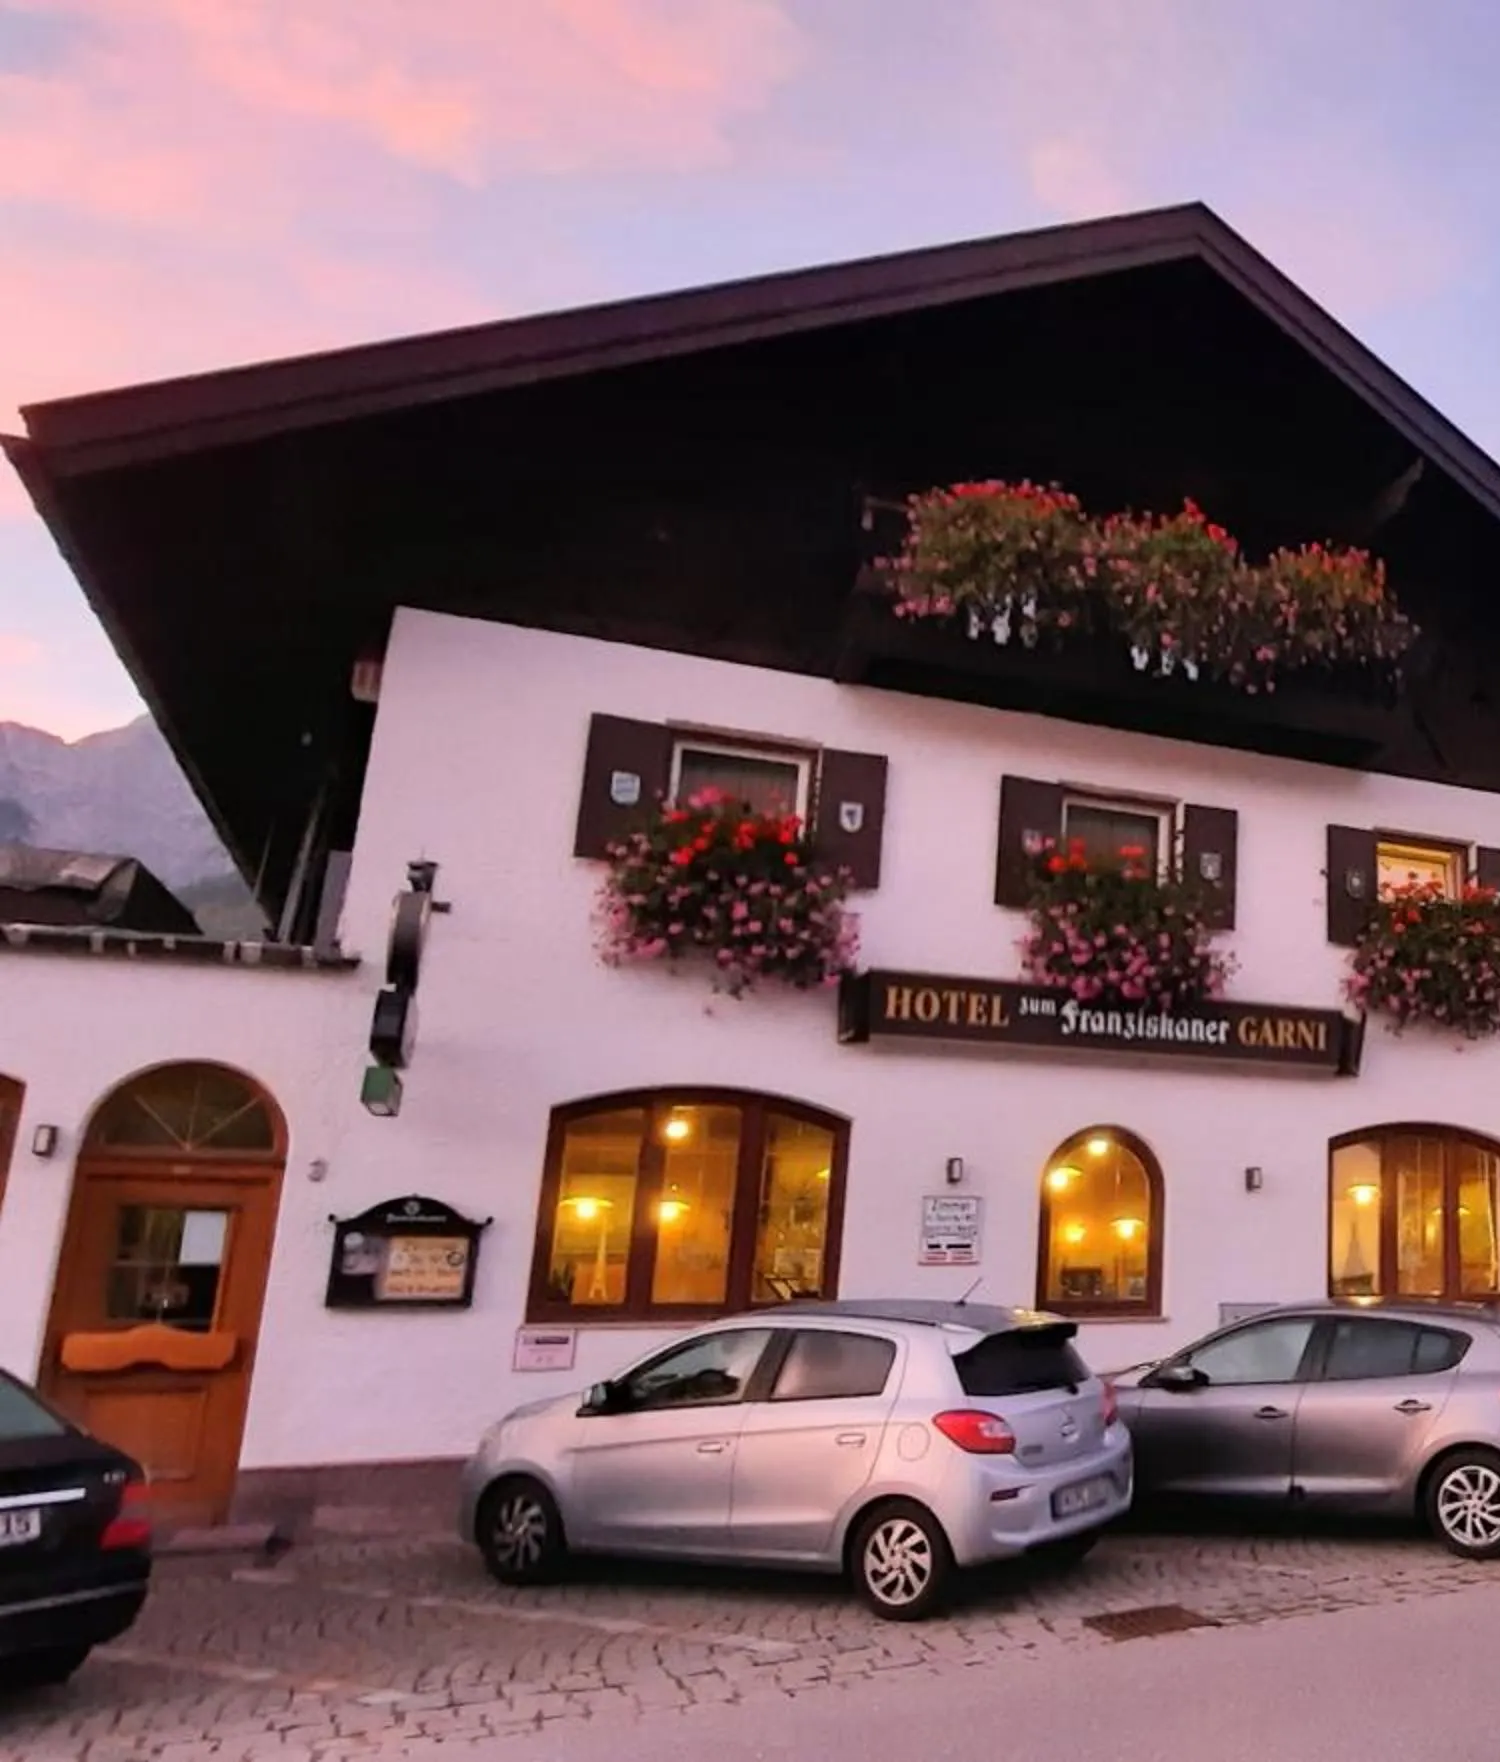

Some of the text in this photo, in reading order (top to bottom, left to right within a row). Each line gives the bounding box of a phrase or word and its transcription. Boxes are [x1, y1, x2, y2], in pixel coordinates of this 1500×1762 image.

[885, 986, 1328, 1051] HOTEL zum Franziskaner GARNI
